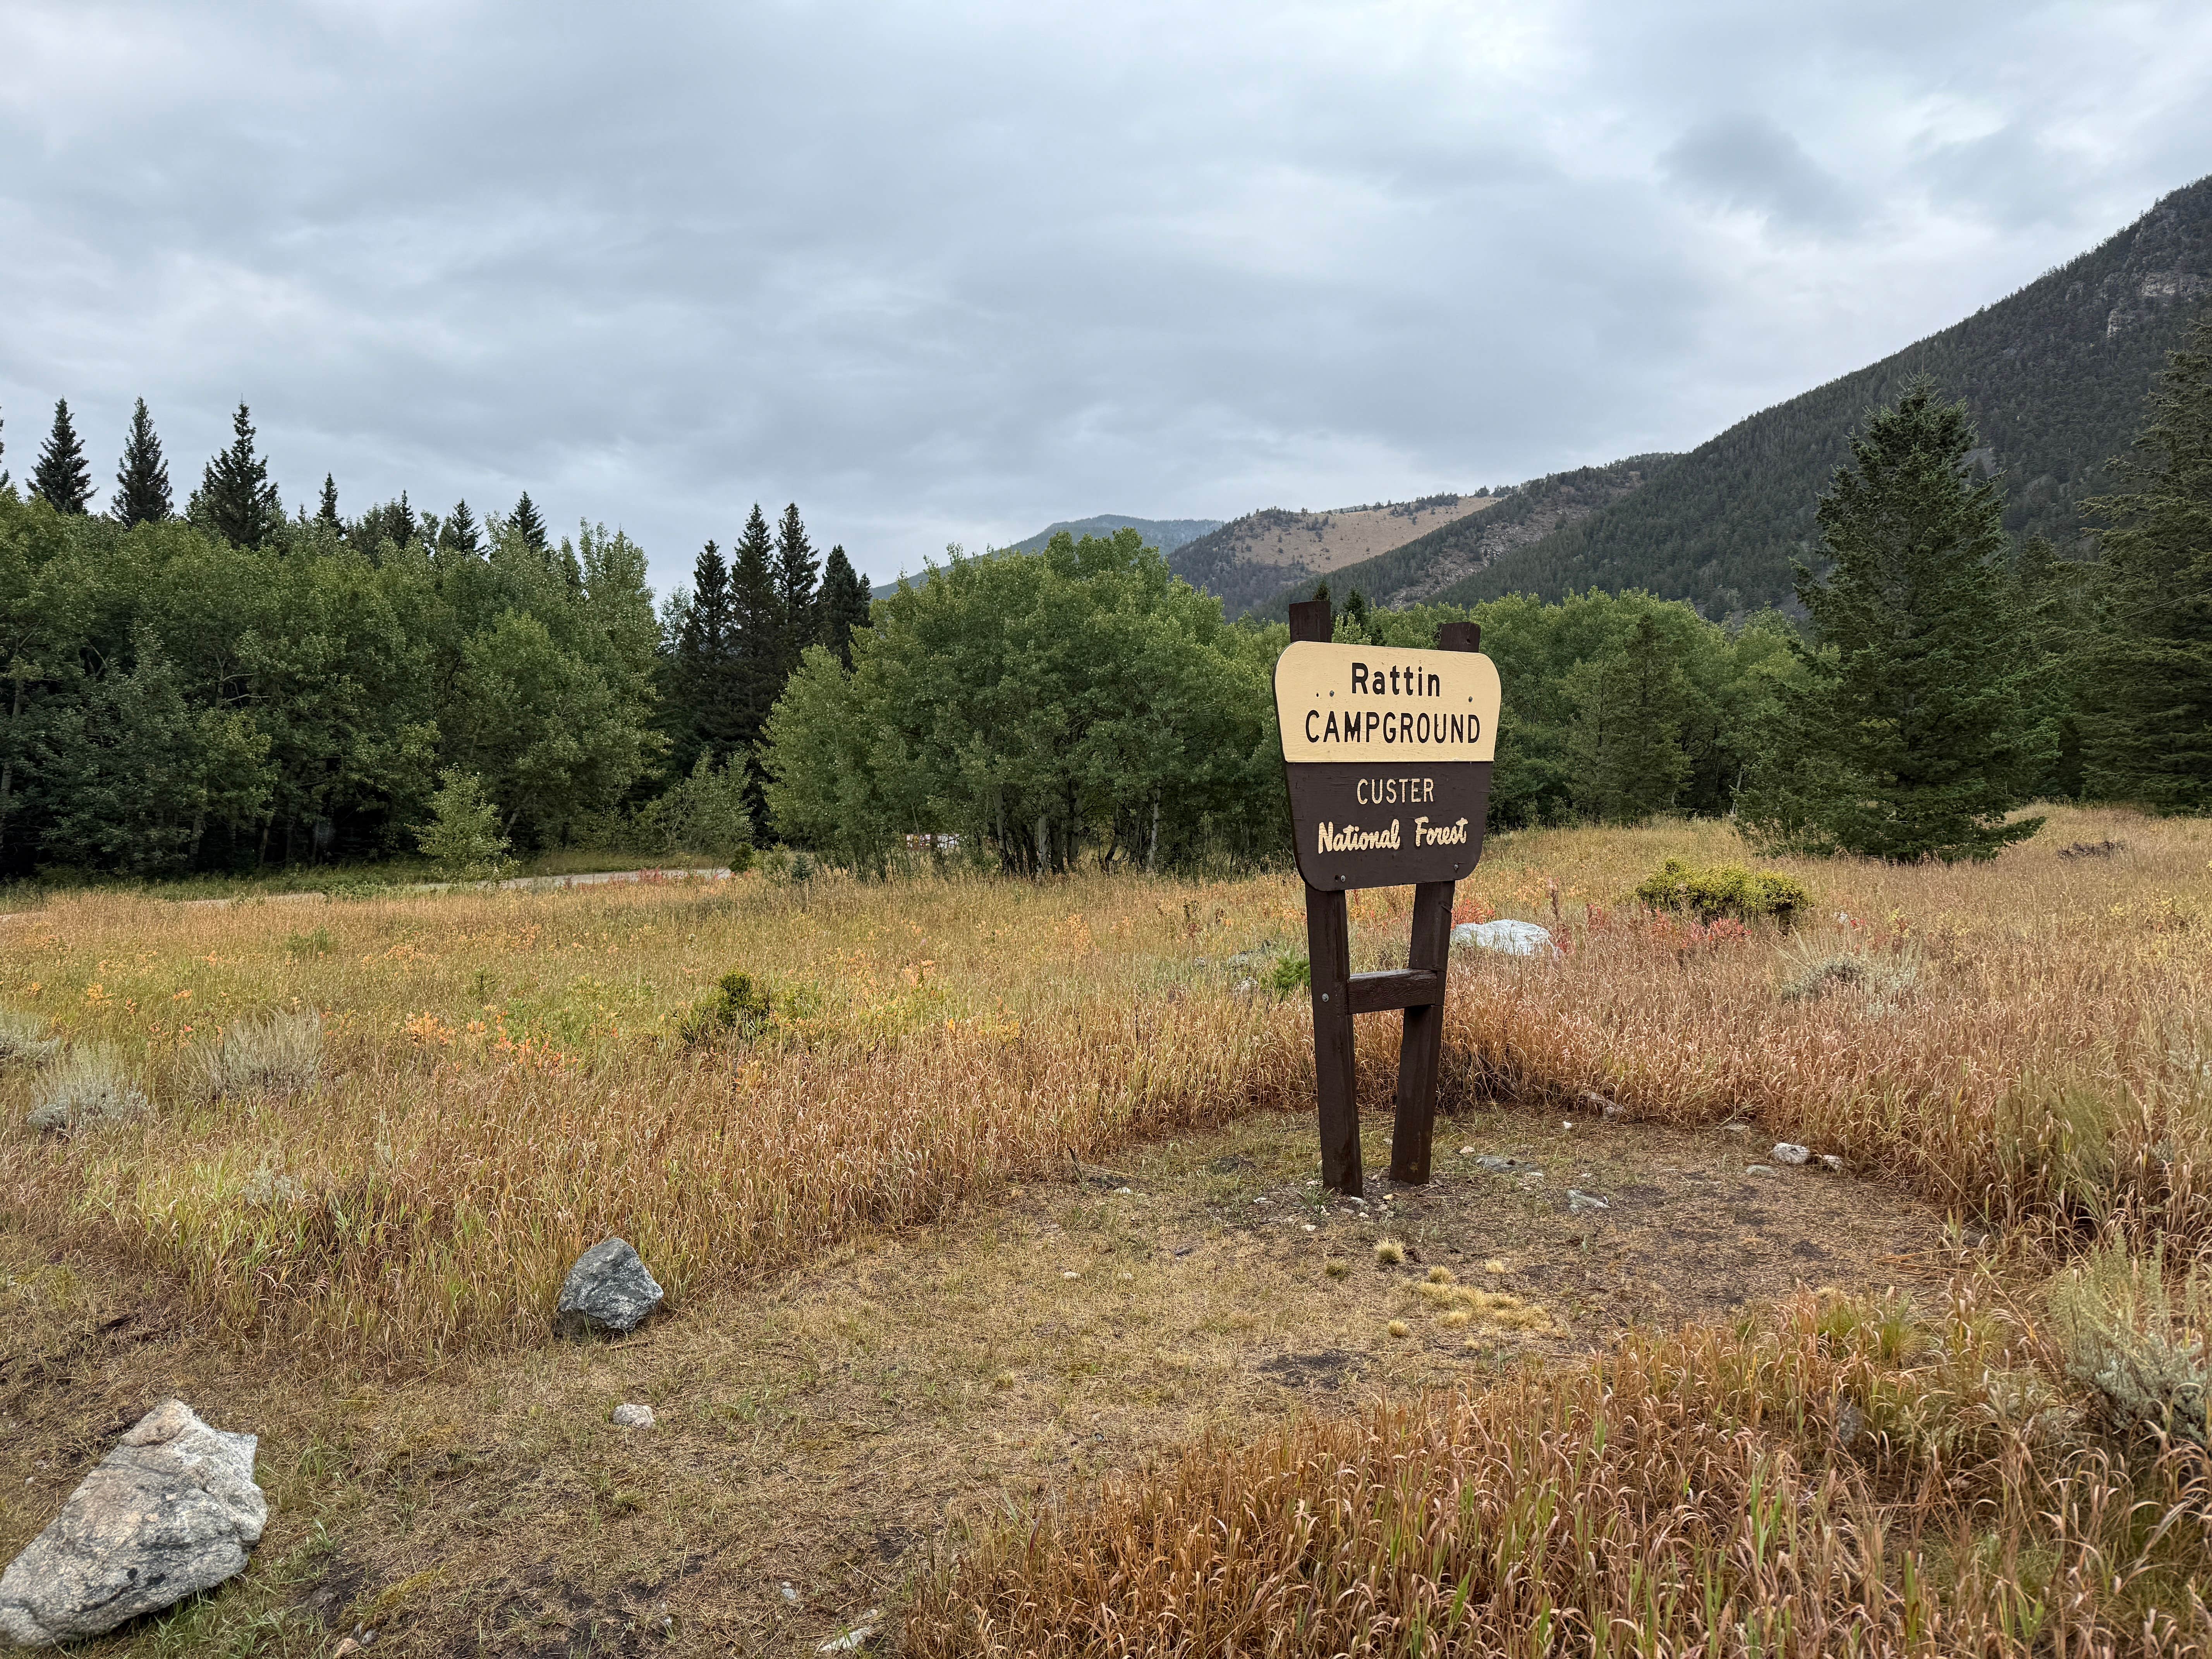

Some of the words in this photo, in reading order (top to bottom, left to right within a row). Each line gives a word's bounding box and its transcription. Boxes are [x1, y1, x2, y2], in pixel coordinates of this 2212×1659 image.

[1352, 663, 1440, 697] Rattin
[1306, 710, 1480, 744] CAMPGROUND
[1357, 778, 1434, 804] CUSTER
[1319, 819, 1400, 854] National
[1415, 816, 1468, 847] Forest
